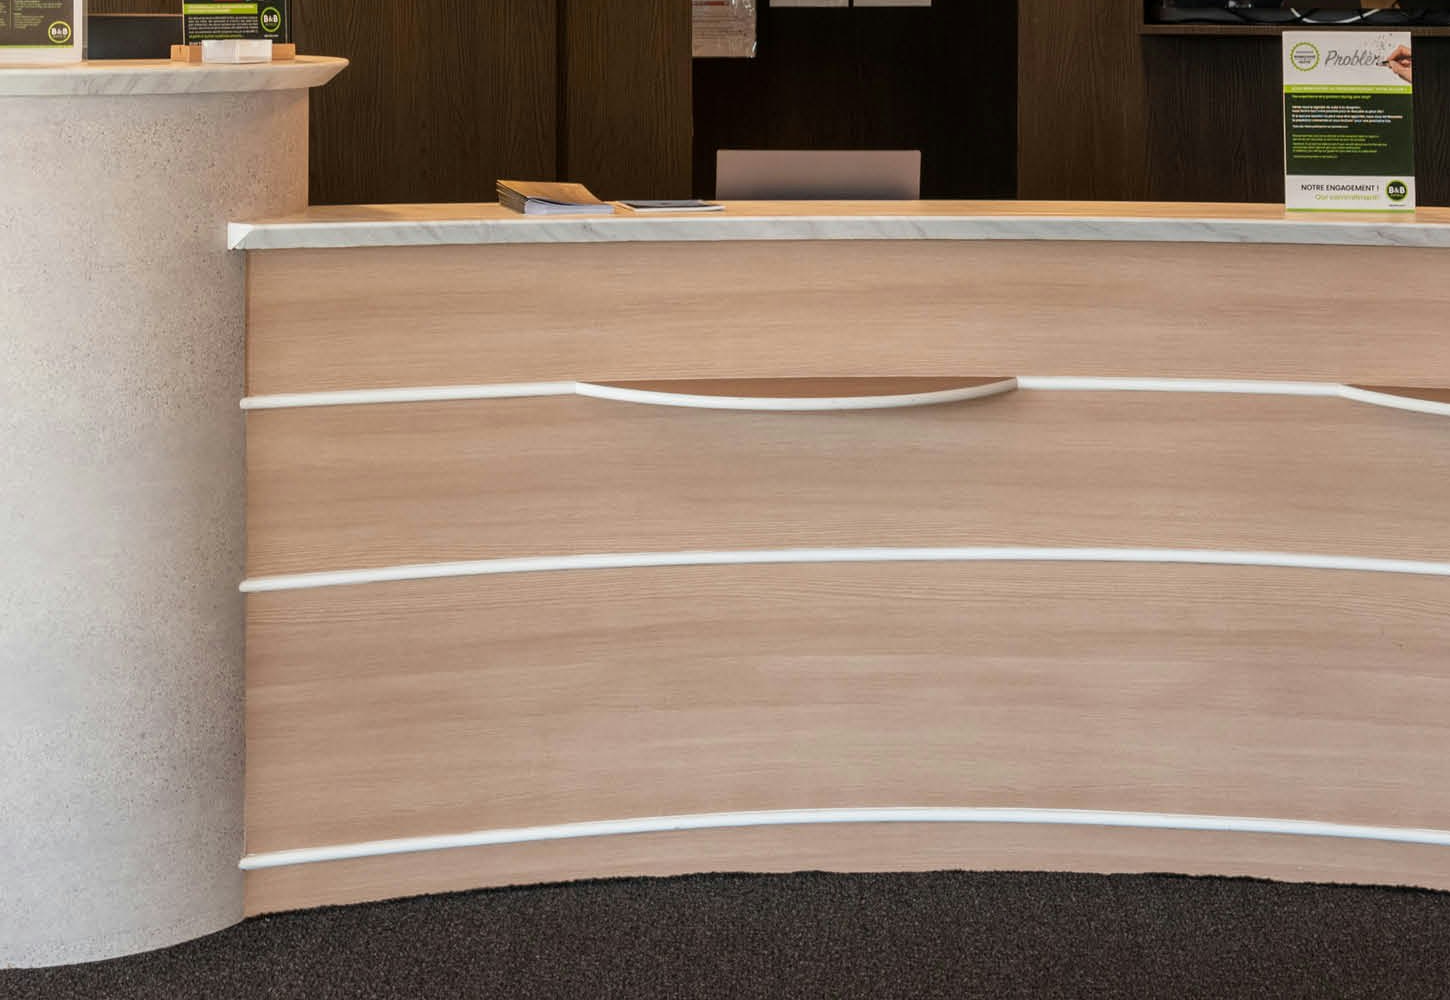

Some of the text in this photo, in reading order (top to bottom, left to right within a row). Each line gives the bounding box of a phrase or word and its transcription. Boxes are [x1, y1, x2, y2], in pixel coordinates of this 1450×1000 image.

[263, 14, 278, 23] B&B
[1301, 184, 1324, 192] NOTRE
[1326, 184, 1375, 192] ENGAGEMENT
[1388, 186, 1406, 194] B&B
